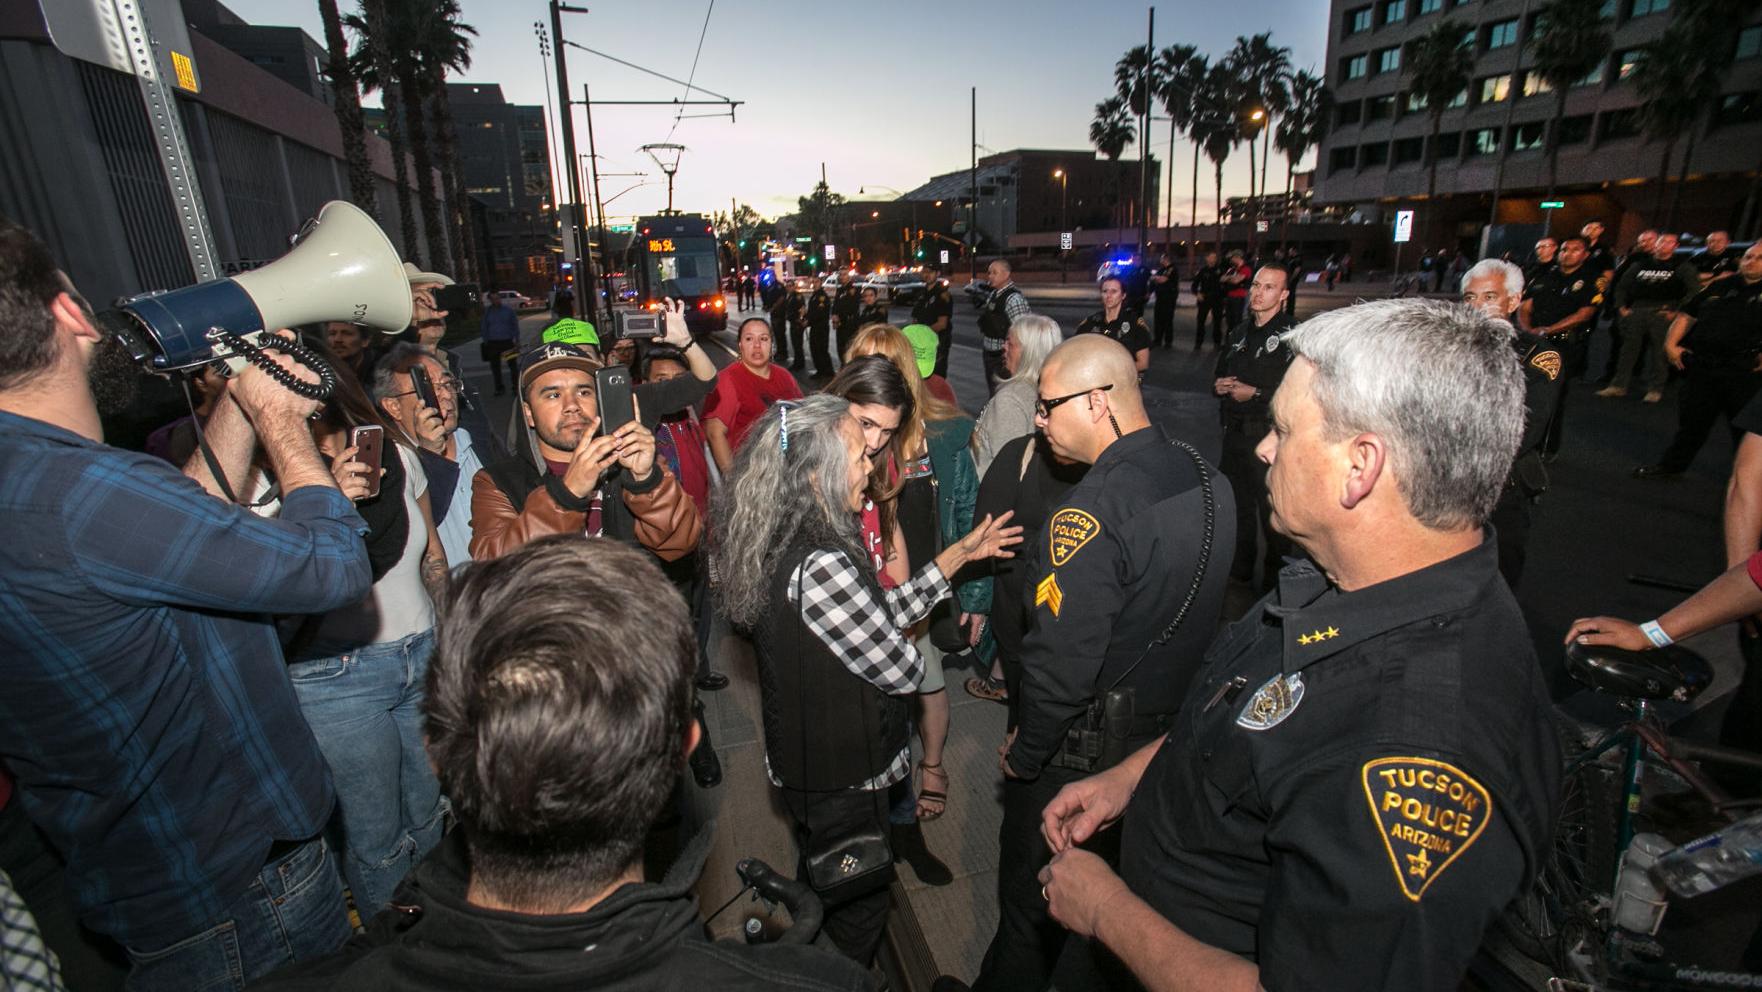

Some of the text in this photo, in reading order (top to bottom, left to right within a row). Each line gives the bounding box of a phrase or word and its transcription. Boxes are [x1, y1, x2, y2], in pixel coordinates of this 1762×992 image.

[1054, 524, 1088, 540] POLICE
[1056, 513, 1093, 530] TUCSON
[1379, 768, 1478, 811] TUCSON
[1381, 790, 1473, 837] POLICE
[1391, 823, 1453, 853] ARIZONA
